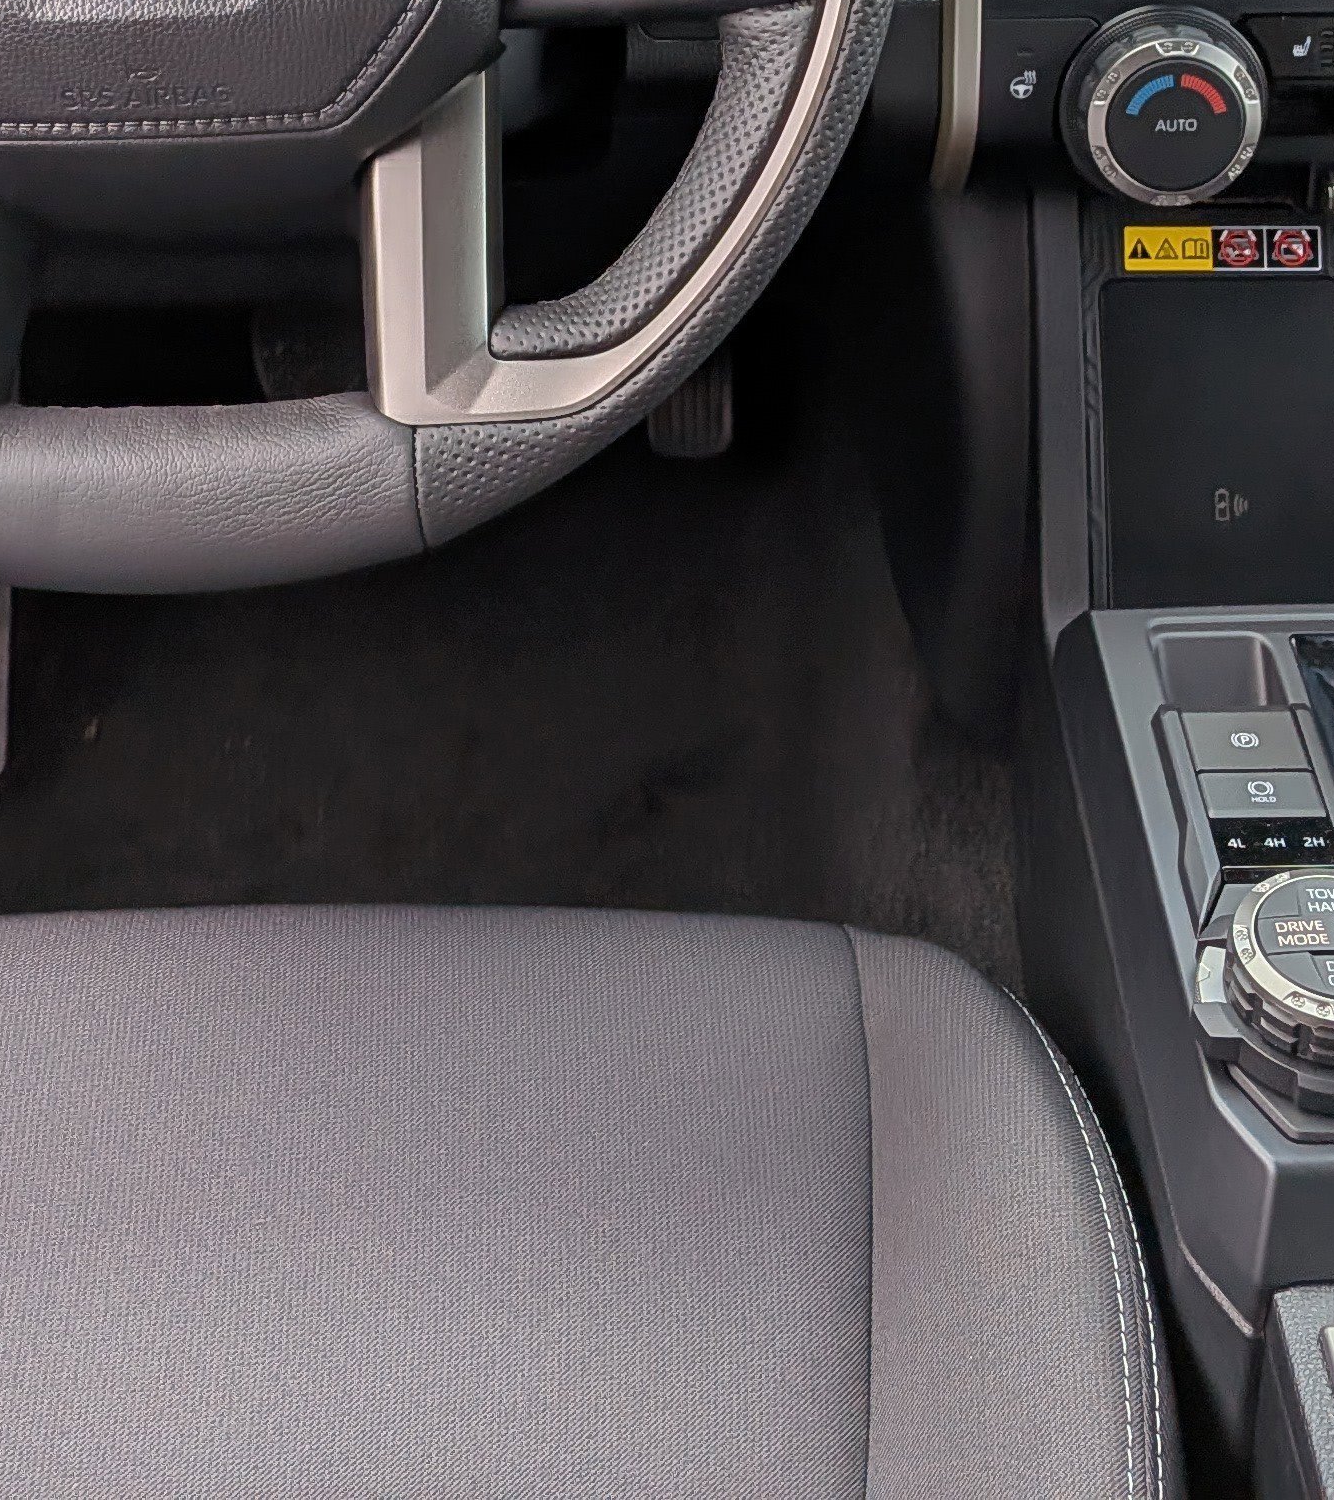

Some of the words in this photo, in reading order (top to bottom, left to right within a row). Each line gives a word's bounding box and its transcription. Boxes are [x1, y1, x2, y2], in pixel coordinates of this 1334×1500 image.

[1155, 118, 1197, 132] AUTO
[1227, 838, 1246, 848] 4L
[1264, 837, 1286, 848] 4H
[1303, 836, 1325, 847] 2H
[1275, 920, 1325, 933] DRIVE
[1278, 933, 1330, 947] MODE
